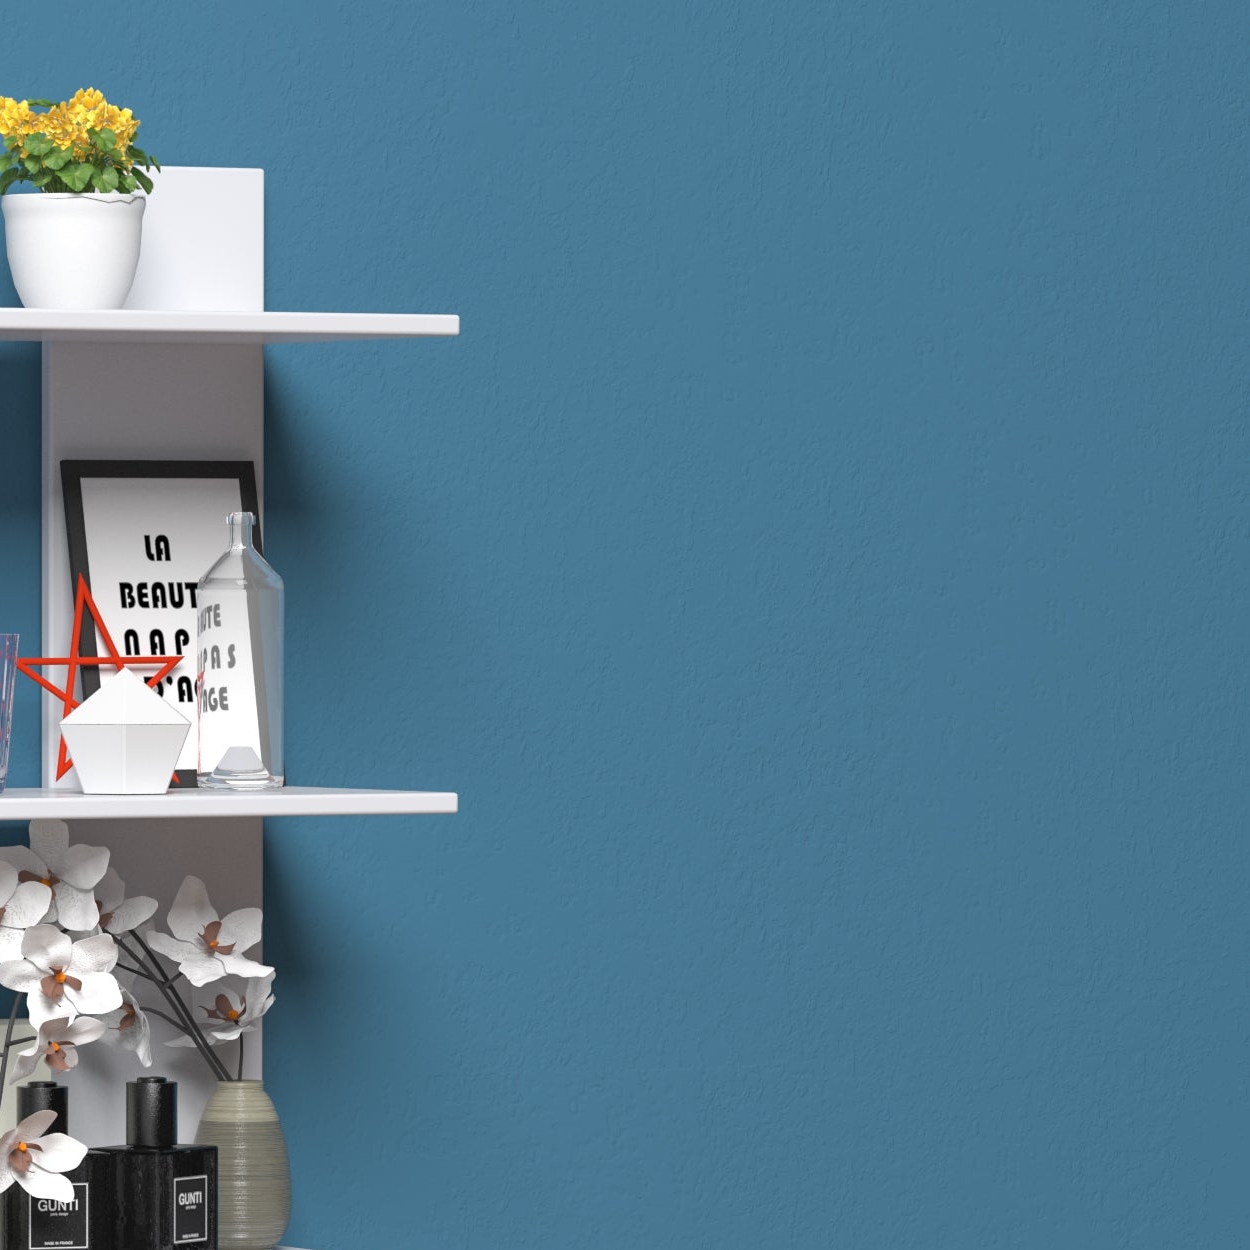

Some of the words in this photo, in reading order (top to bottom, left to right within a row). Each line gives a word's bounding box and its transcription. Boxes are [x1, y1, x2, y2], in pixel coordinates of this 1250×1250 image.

[144, 534, 171, 562] LA
[37, 1199, 79, 1211] GUNTI
[178, 1191, 202, 1206] GUNTI
